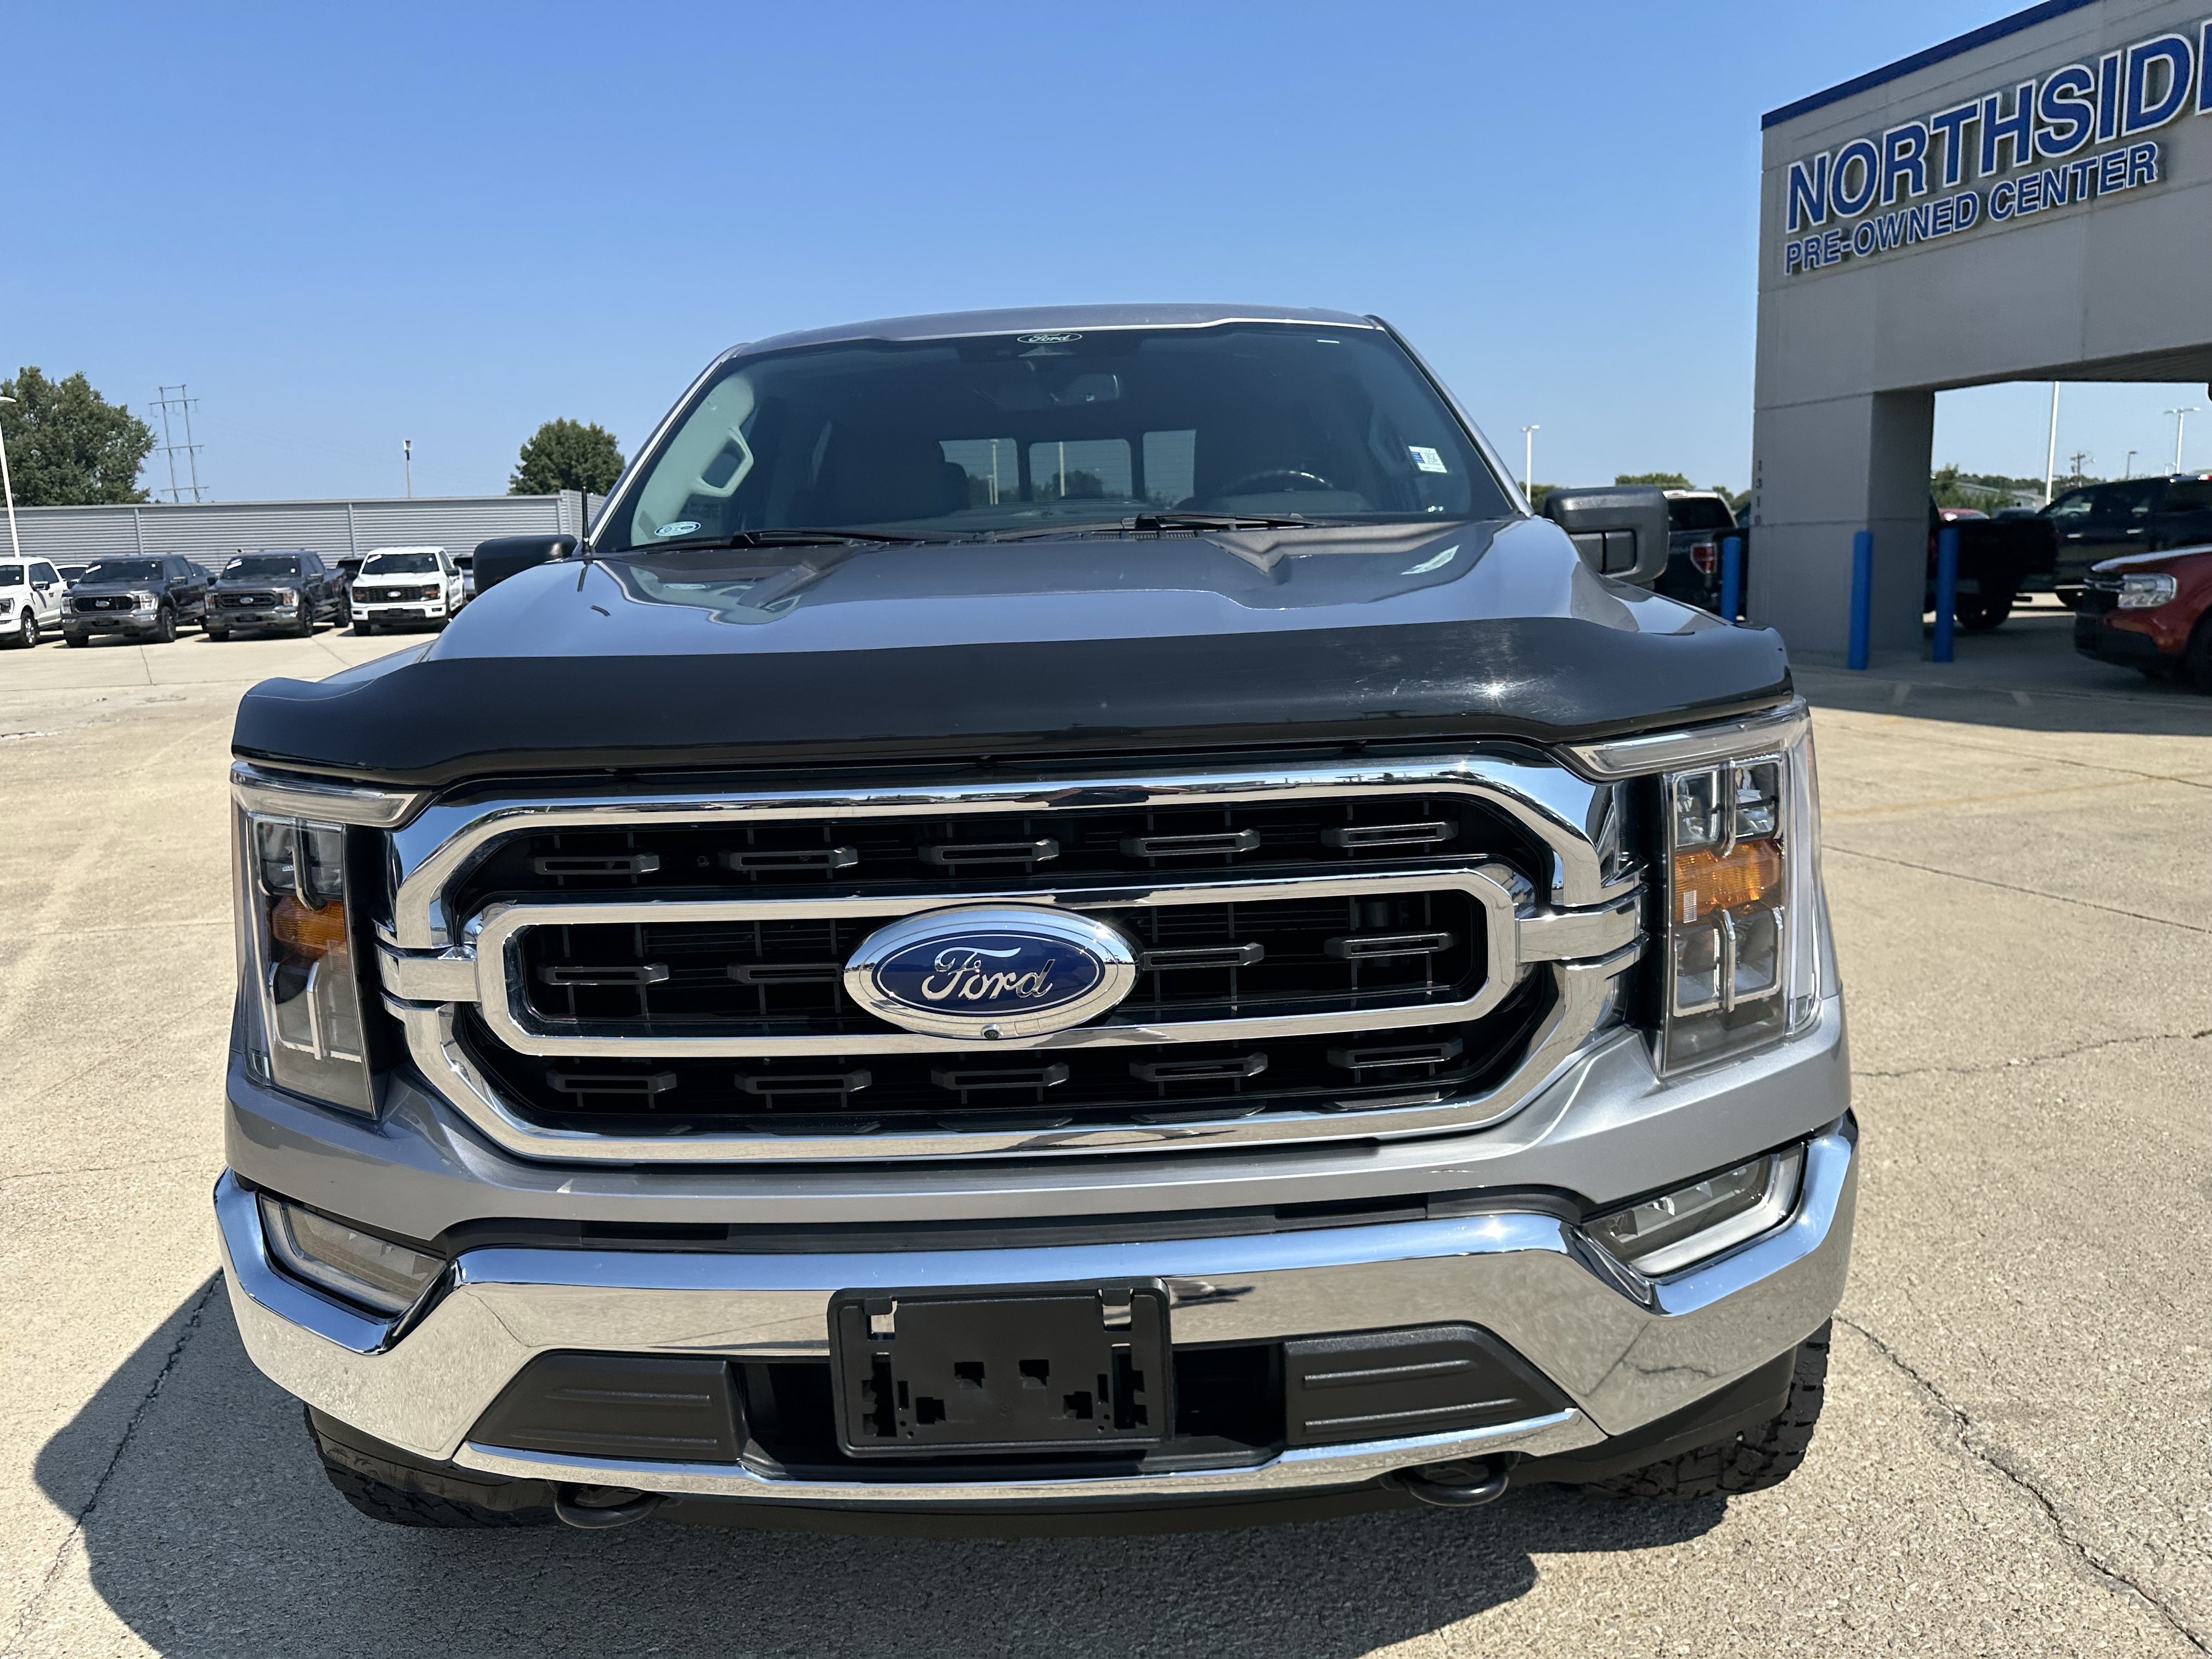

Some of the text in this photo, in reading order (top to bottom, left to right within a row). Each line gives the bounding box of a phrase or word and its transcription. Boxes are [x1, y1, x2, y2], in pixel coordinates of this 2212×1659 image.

[1786, 19, 2212, 234] NORTHSID
[1784, 141, 2158, 275] PRE-OWNED CENTER
[1028, 334, 1071, 342] Ford
[922, 947, 1055, 1001] Ford
